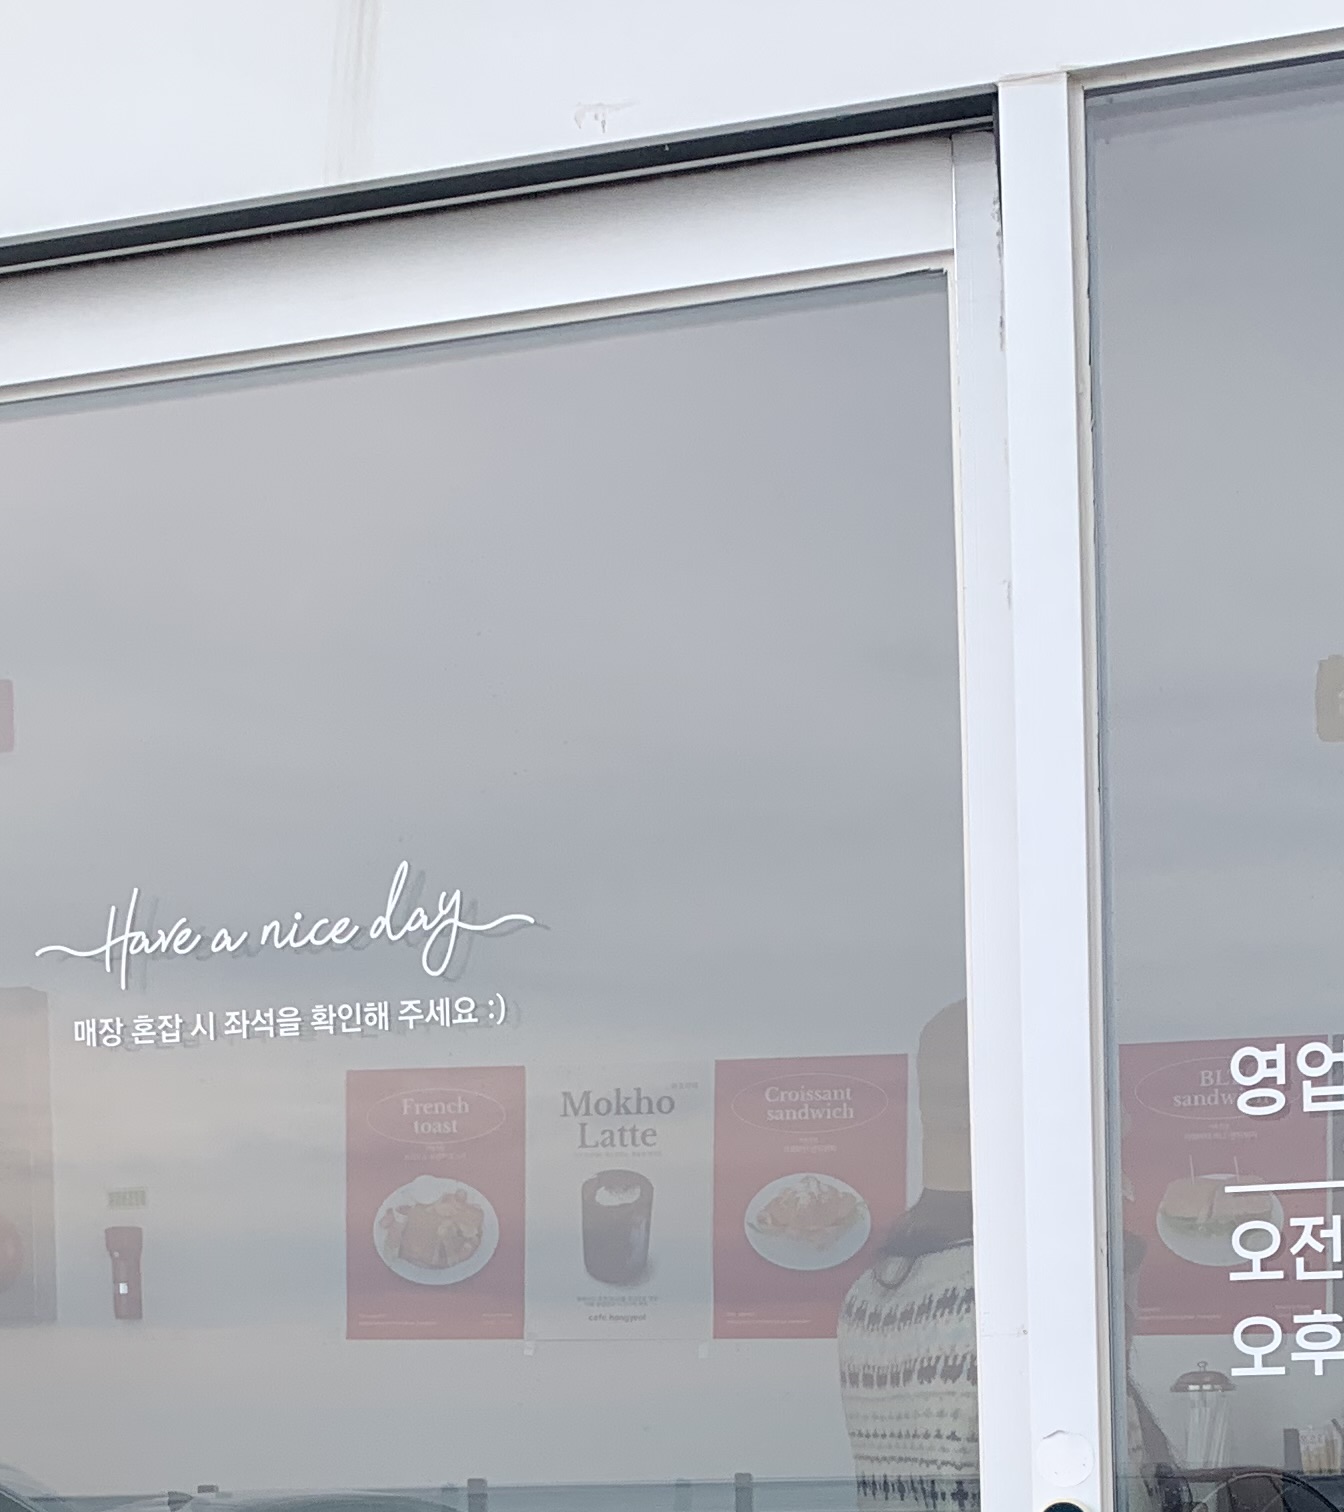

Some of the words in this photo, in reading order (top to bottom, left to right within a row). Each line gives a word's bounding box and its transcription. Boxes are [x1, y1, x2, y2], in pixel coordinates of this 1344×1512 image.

[35, 887, 201, 990] Have
[211, 922, 247, 953] a
[260, 911, 359, 951] nice
[369, 860, 535, 977] day
[73, 1015, 125, 1050] 매장
[131, 1012, 183, 1046] 혼잡
[190, 1010, 216, 1041] 시
[223, 1004, 302, 1041] 좌석을
[310, 999, 390, 1033] 확인해
[398, 996, 479, 1029] 주세요
[402, 1095, 470, 1116] French
[560, 1087, 676, 1118] Mokho
[764, 1084, 852, 1102] Croissant
[766, 1103, 854, 1121] sandwich
[413, 1119, 458, 1135] toast
[577, 1121, 658, 1149] Latte
[1229, 1213, 1344, 1283] 오전
